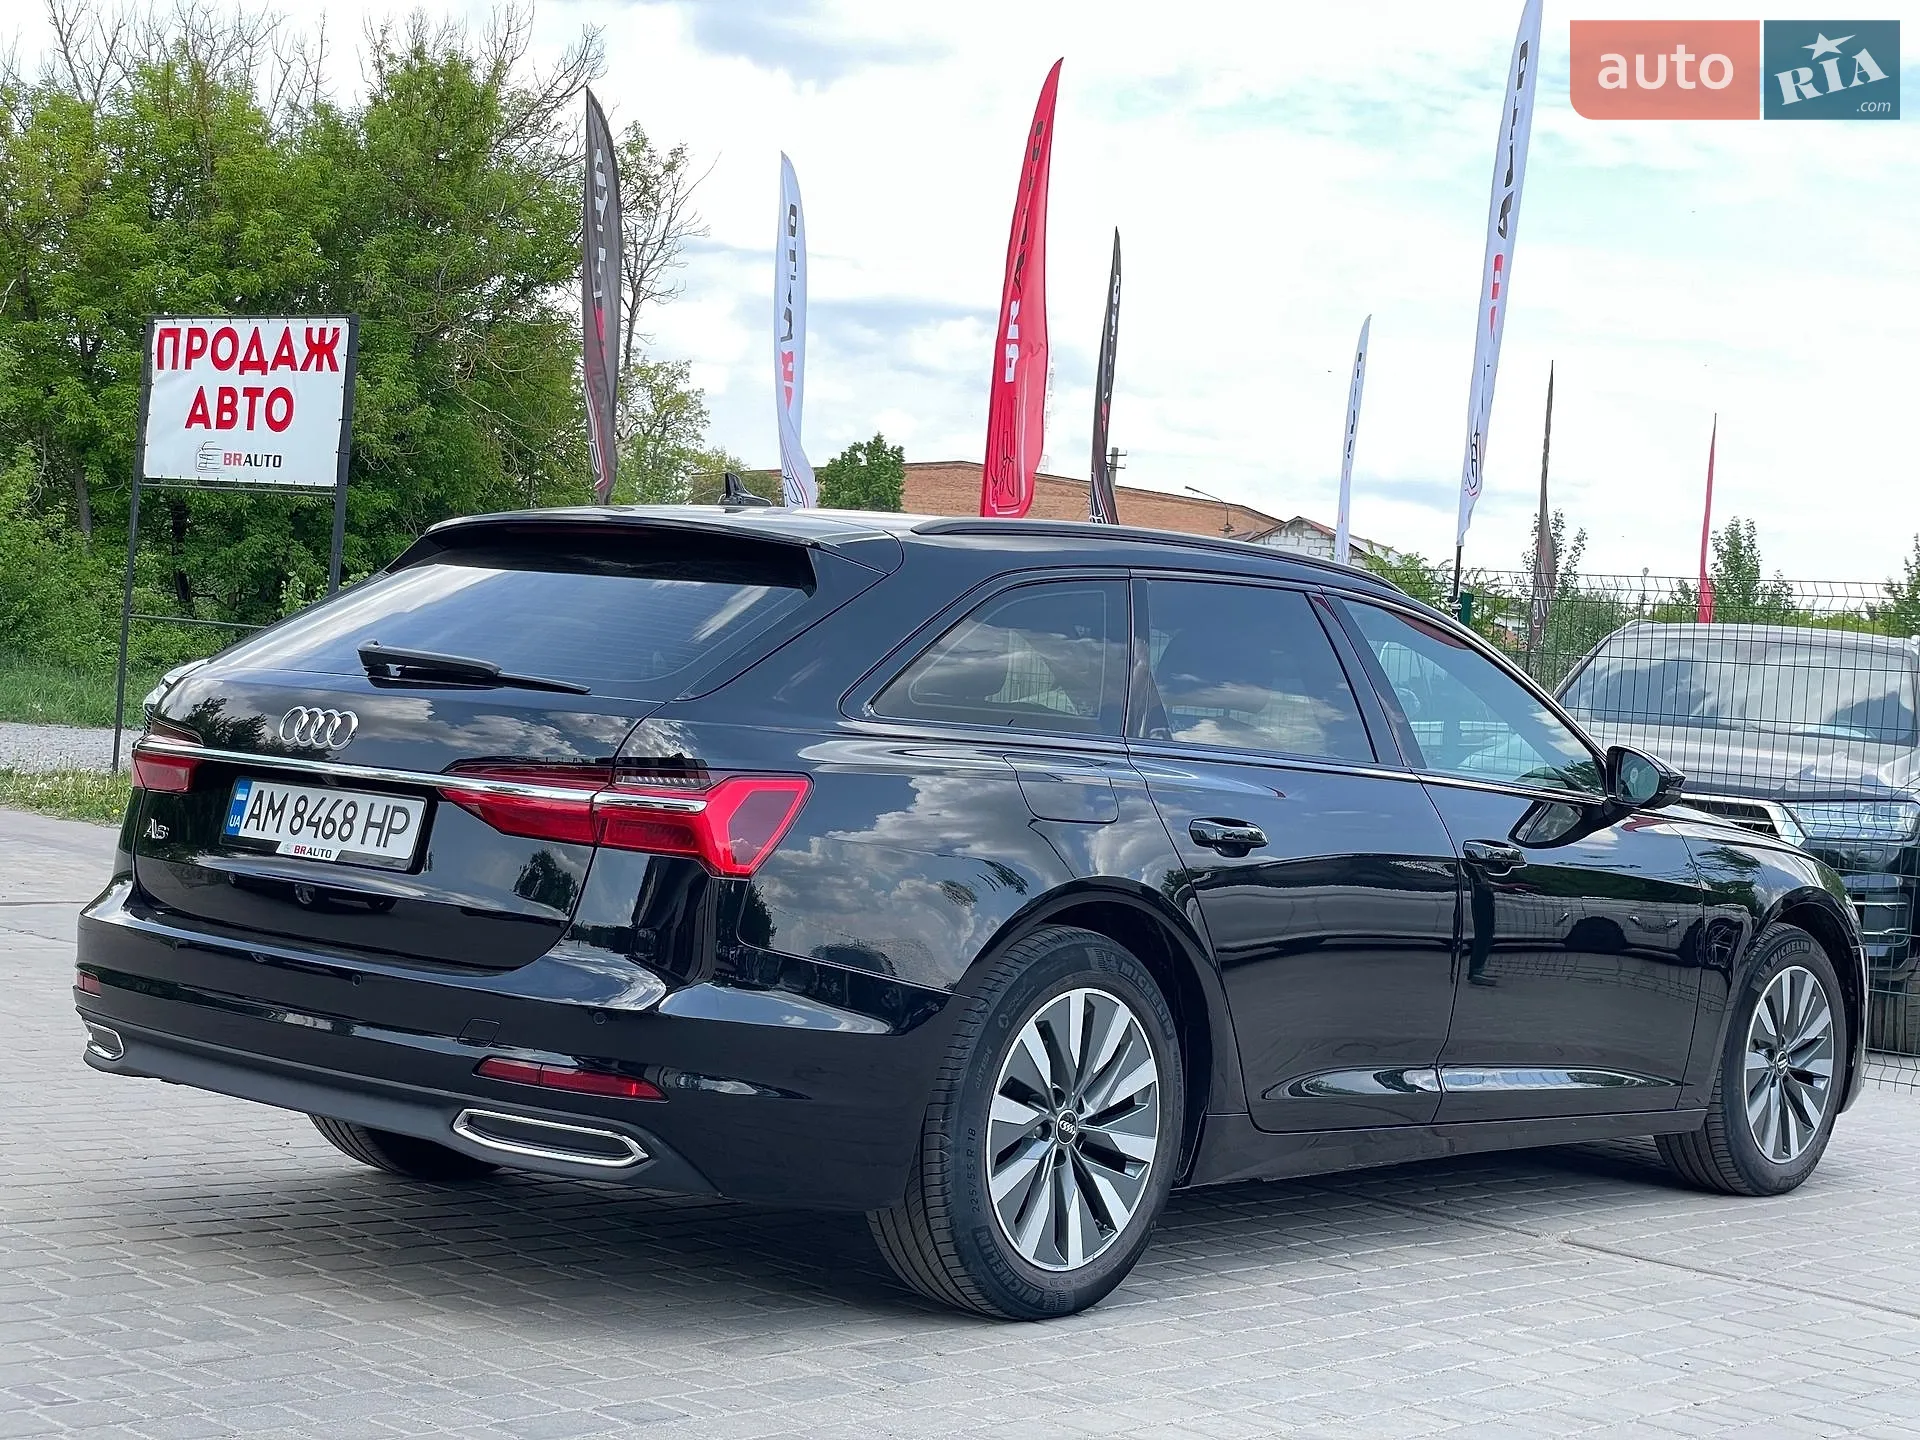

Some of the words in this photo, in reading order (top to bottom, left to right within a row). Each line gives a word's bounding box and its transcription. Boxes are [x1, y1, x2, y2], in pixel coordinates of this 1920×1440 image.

[157, 326, 340, 375] ПРОДАЖ
[185, 386, 294, 433] АВТО
[223, 453, 282, 468] BRAUTO
[230, 815, 241, 827] UA
[244, 790, 289, 834] AM
[289, 795, 359, 842] 8468
[361, 802, 411, 848] HP
[294, 845, 332, 859] BRAUTO
[1770, 941, 1809, 967] MICHELIN
[1120, 958, 1175, 1040] MICHELIN
[968, 1127, 976, 1142] 18
[966, 1149, 975, 1159] R
[967, 1163, 980, 1213] 225/55
